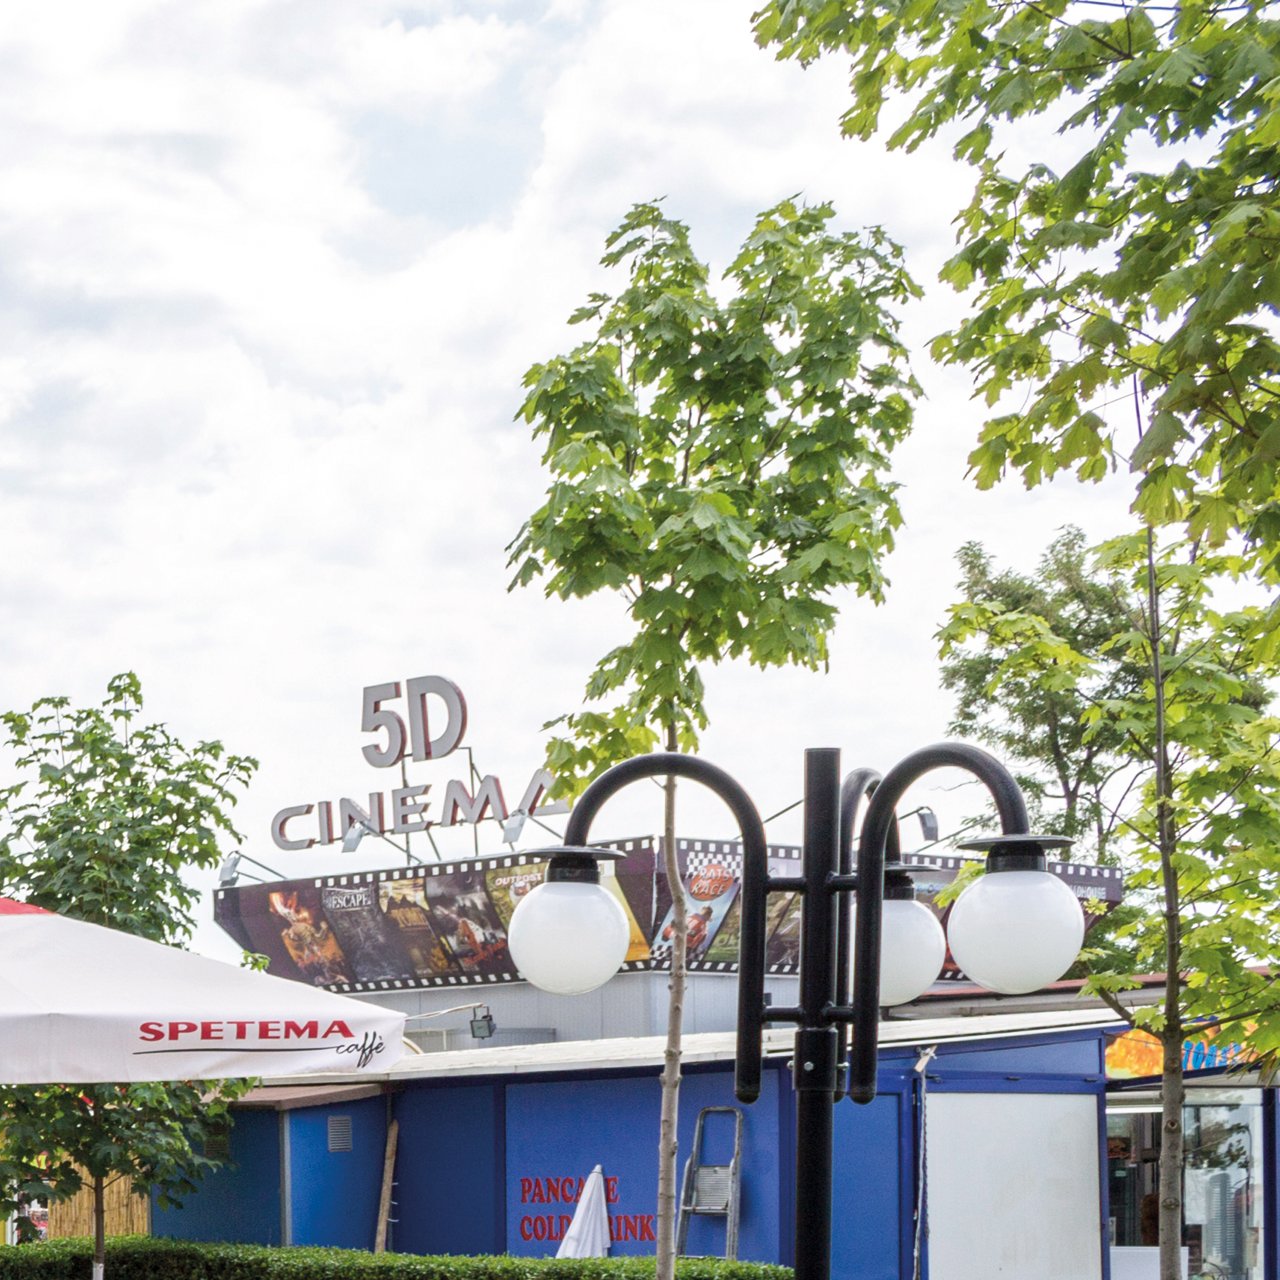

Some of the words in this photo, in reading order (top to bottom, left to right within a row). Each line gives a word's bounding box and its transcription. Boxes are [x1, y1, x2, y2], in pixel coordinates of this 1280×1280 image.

[361, 675, 468, 768] 5D
[271, 768, 571, 851] CINEMA
[495, 873, 543, 886] OUTPOST
[332, 893, 371, 909] ESCAPE
[139, 1020, 355, 1041] SPETEMA
[521, 1176, 619, 1203] PANCAE
